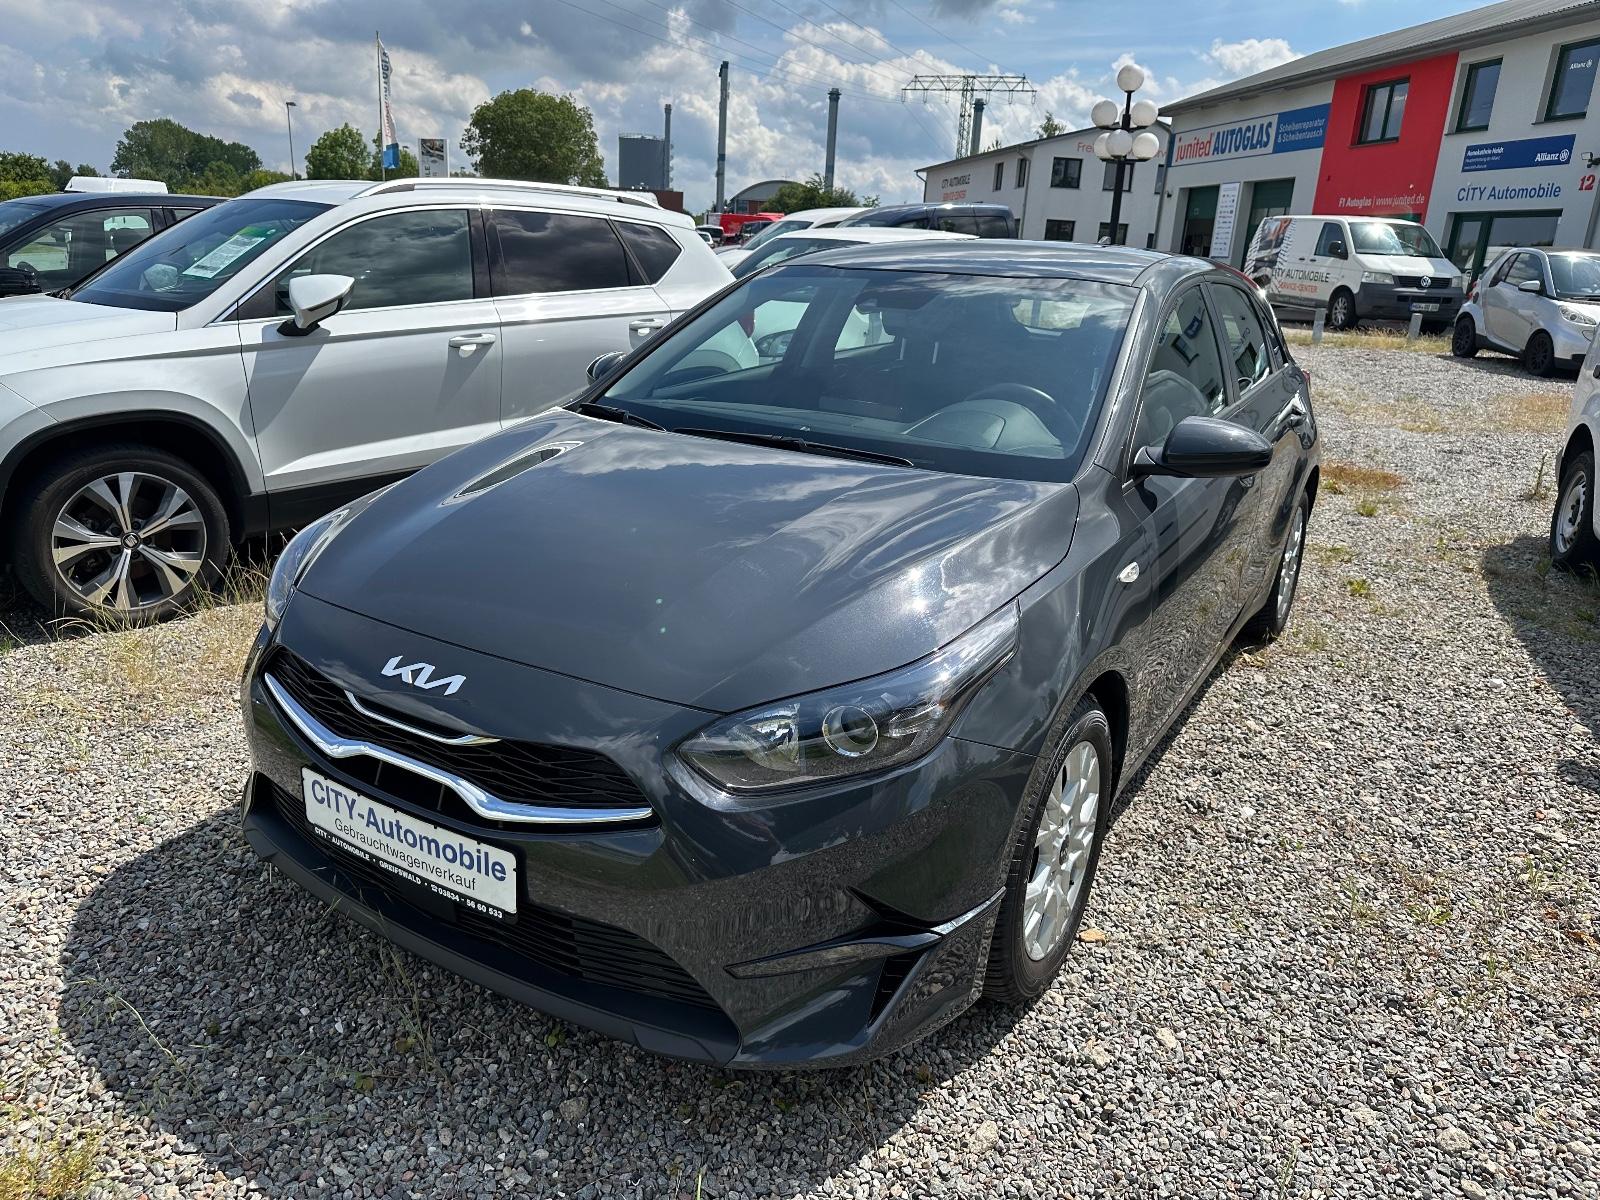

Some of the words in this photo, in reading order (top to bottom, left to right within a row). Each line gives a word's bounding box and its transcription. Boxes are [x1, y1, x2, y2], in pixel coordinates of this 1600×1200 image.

[1279, 118, 1325, 133] Scheibenreparatur
[1282, 127, 1323, 142] Scheibentausch
[1174, 131, 1213, 163] junited
[1212, 121, 1272, 155] AUTOGLAS
[1535, 152, 1559, 162] Allianz
[1579, 174, 1596, 191] 12
[1345, 195, 1372, 209] Autoglas
[1376, 194, 1425, 208] www.junited.de
[1457, 186, 1486, 202] CITY
[1487, 183, 1561, 200] Automobile
[1286, 269, 1330, 283] AUTOMOBILE
[380, 655, 466, 696] KIA
[311, 779, 506, 882] CITY-Automobile
[334, 817, 477, 891] Gebrauchtwagenverkauf
[314, 826, 328, 838] CITY
[331, 836, 370, 861] AUTOMOBILE
[379, 860, 422, 885] GREIFSWALD
[466, 899, 476, 909] 56
[477, 903, 487, 913] 60
[488, 907, 503, 919] 533
